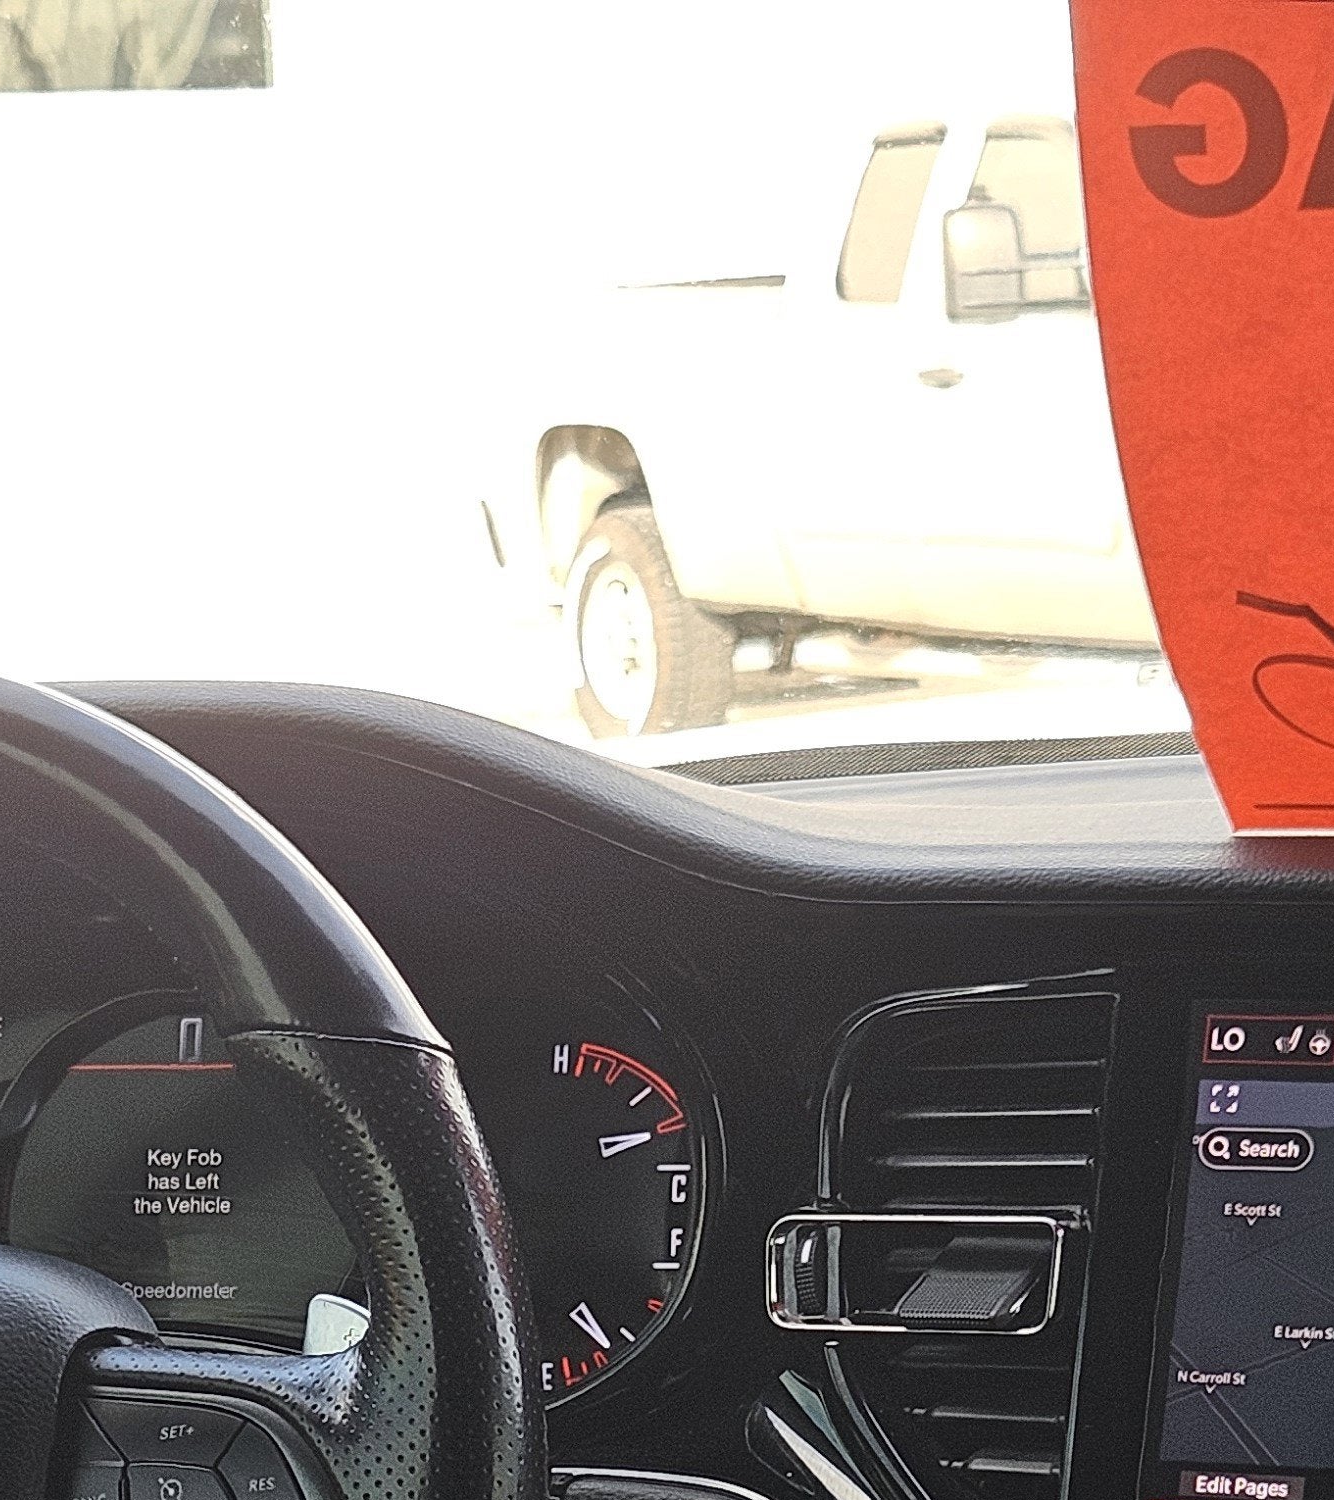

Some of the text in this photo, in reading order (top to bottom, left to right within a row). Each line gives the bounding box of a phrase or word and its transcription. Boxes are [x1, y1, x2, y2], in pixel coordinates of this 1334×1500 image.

[1211, 1026, 1245, 1052] LO
[554, 1044, 569, 1074] H
[147, 1149, 222, 1169] Key Fob
[1239, 1139, 1300, 1159] Search
[148, 1173, 219, 1190] has Left
[670, 1174, 687, 1203] C
[134, 1196, 231, 1214] the Vehicle
[1224, 1203, 1282, 1217] E Scott St
[669, 1228, 683, 1255] F
[1274, 1326, 1283, 1339] E
[1285, 1326, 1325, 1341] Larkin
[542, 1363, 553, 1390] E
[1177, 1370, 1246, 1386] N Carroll St
[159, 1425, 195, 1440] SET+
[248, 1478, 276, 1492] RES
[1195, 1475, 1289, 1499] Edit Pages
